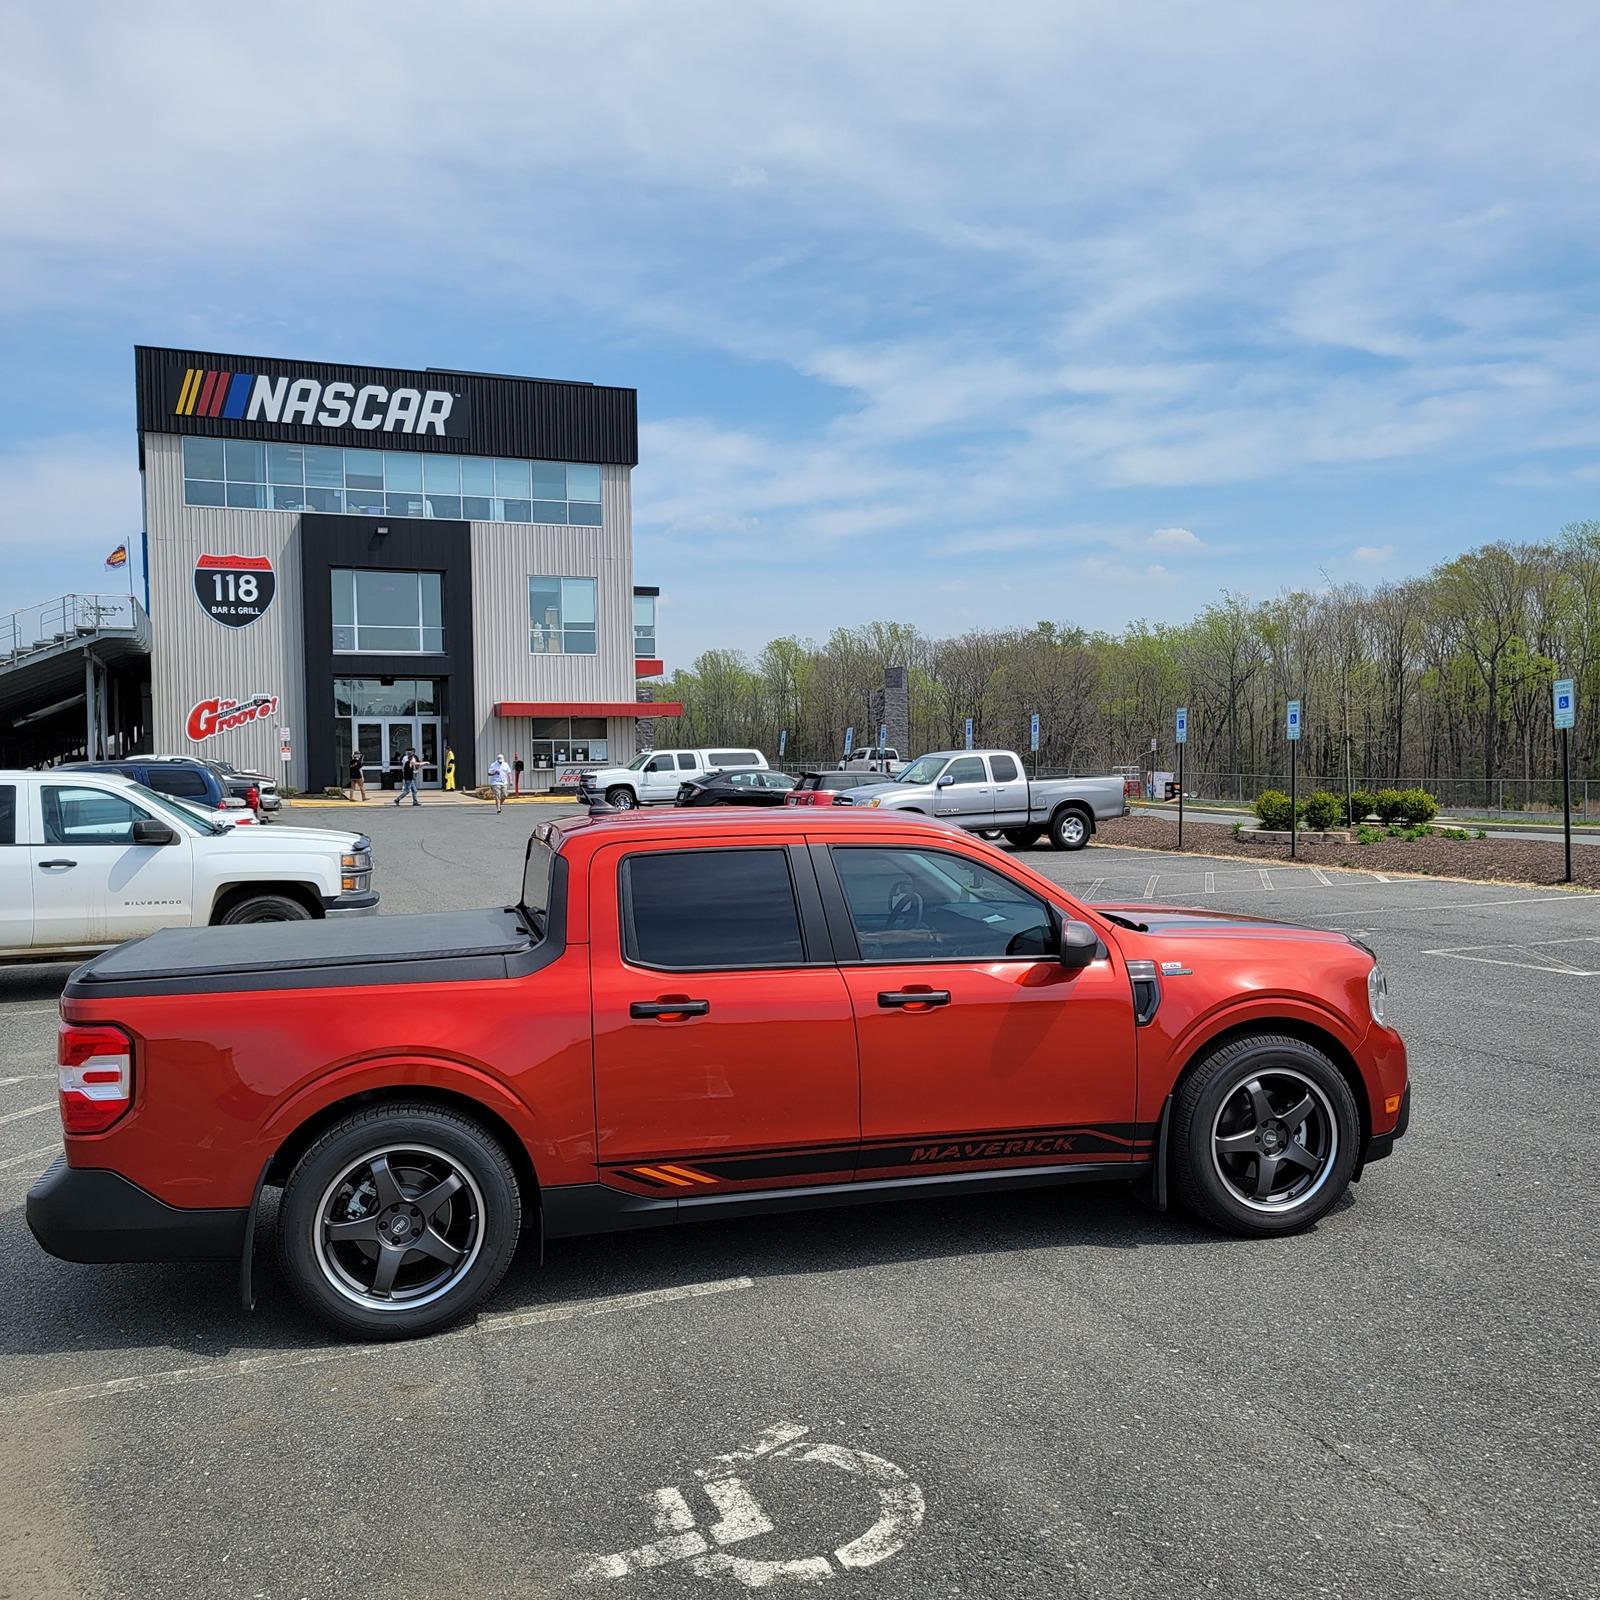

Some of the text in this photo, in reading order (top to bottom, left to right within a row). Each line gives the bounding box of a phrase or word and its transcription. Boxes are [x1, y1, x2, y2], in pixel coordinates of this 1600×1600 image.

[246, 375, 453, 436] NASCAR
[212, 574, 258, 602] 118
[211, 606, 261, 615] BAR & GRILL
[910, 1137, 1077, 1161] MAVERICK
